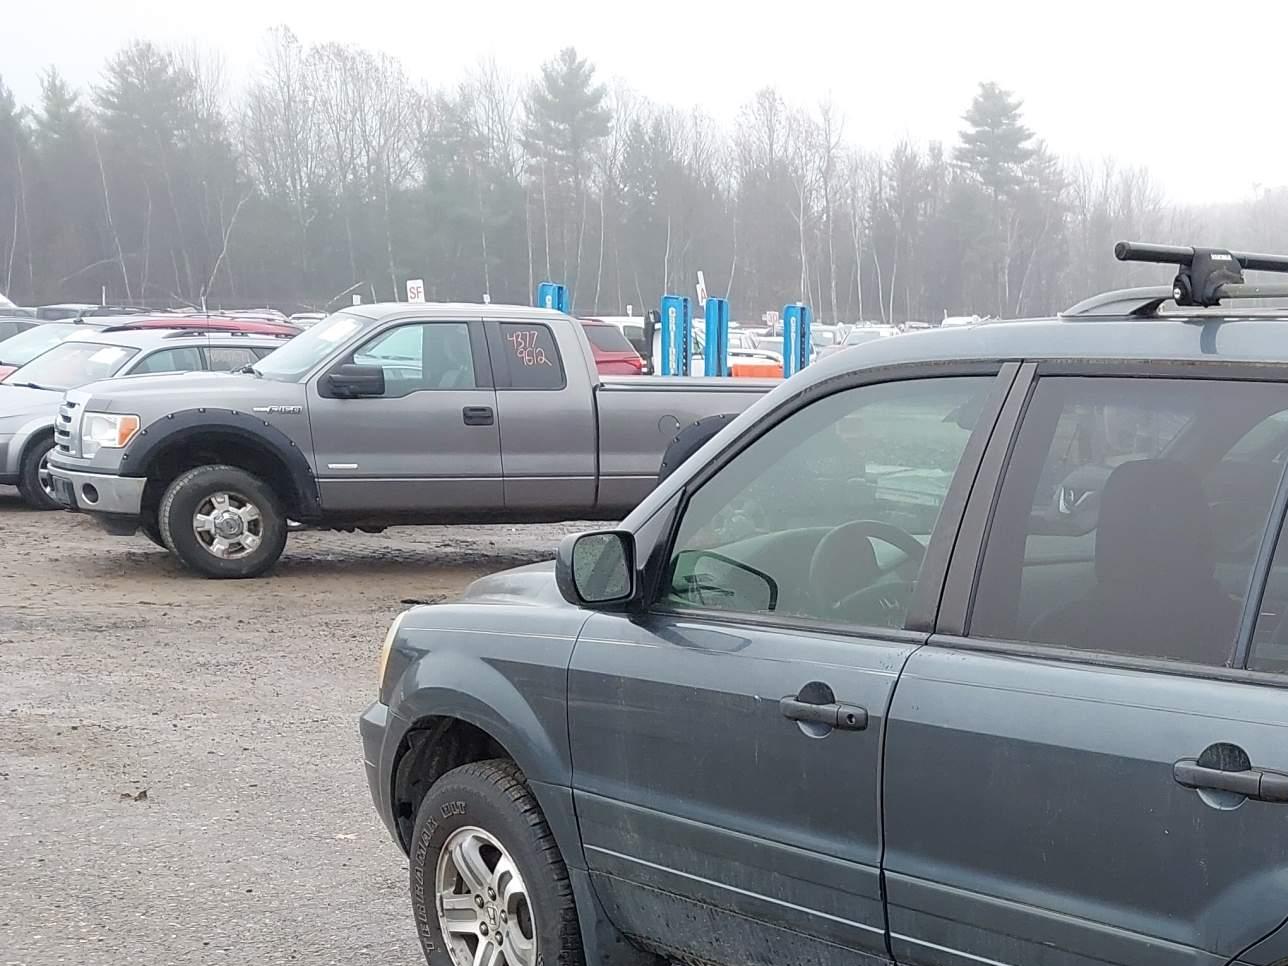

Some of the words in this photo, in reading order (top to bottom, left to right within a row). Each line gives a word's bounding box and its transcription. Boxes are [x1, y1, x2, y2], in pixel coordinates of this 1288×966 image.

[409, 286, 422, 300] SF
[507, 330, 538, 350] 4377
[517, 347, 552, 366] 9612
